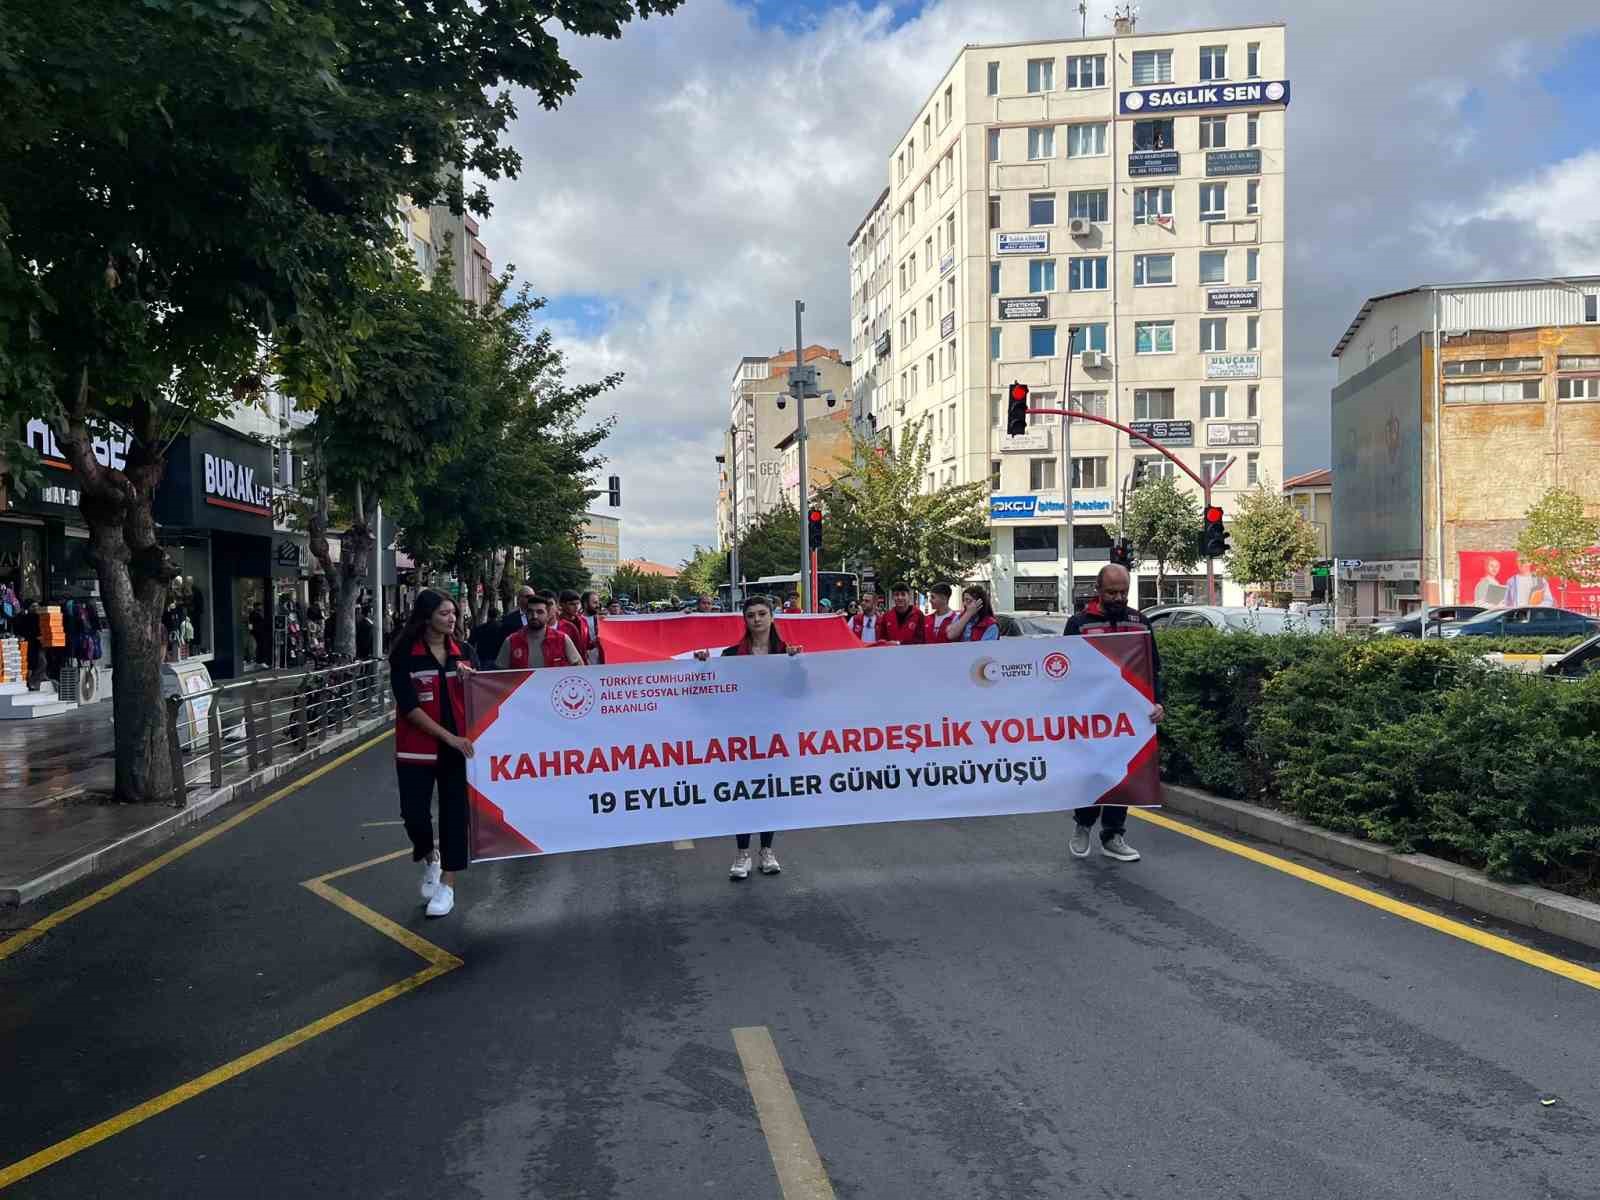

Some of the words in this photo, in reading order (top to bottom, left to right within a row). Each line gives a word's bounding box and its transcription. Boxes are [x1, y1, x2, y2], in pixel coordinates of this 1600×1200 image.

[1223, 86, 1260, 101] SEN
[204, 453, 255, 504] BURAK
[600, 675, 645, 687] TÜRKİYE
[646, 671, 716, 685] CUMHURİYETİ
[600, 689, 623, 701] AİLE
[625, 689, 638, 699] VE
[640, 687, 678, 699] SOSYAL
[681, 683, 738, 696] HİZMETLER
[601, 702, 657, 715] BAKANLIĞI
[490, 733, 790, 782] KAHRAMANLARLA
[799, 716, 974, 757] KARDEŞLİK
[981, 712, 1136, 745] YOLUNDA
[589, 791, 617, 814] 19
[625, 780, 706, 812] EYLÜL
[714, 773, 822, 802] GAZİLER
[829, 764, 900, 793] GÜNÜ
[905, 755, 1047, 786] YÜRÜYÜŞÜ
